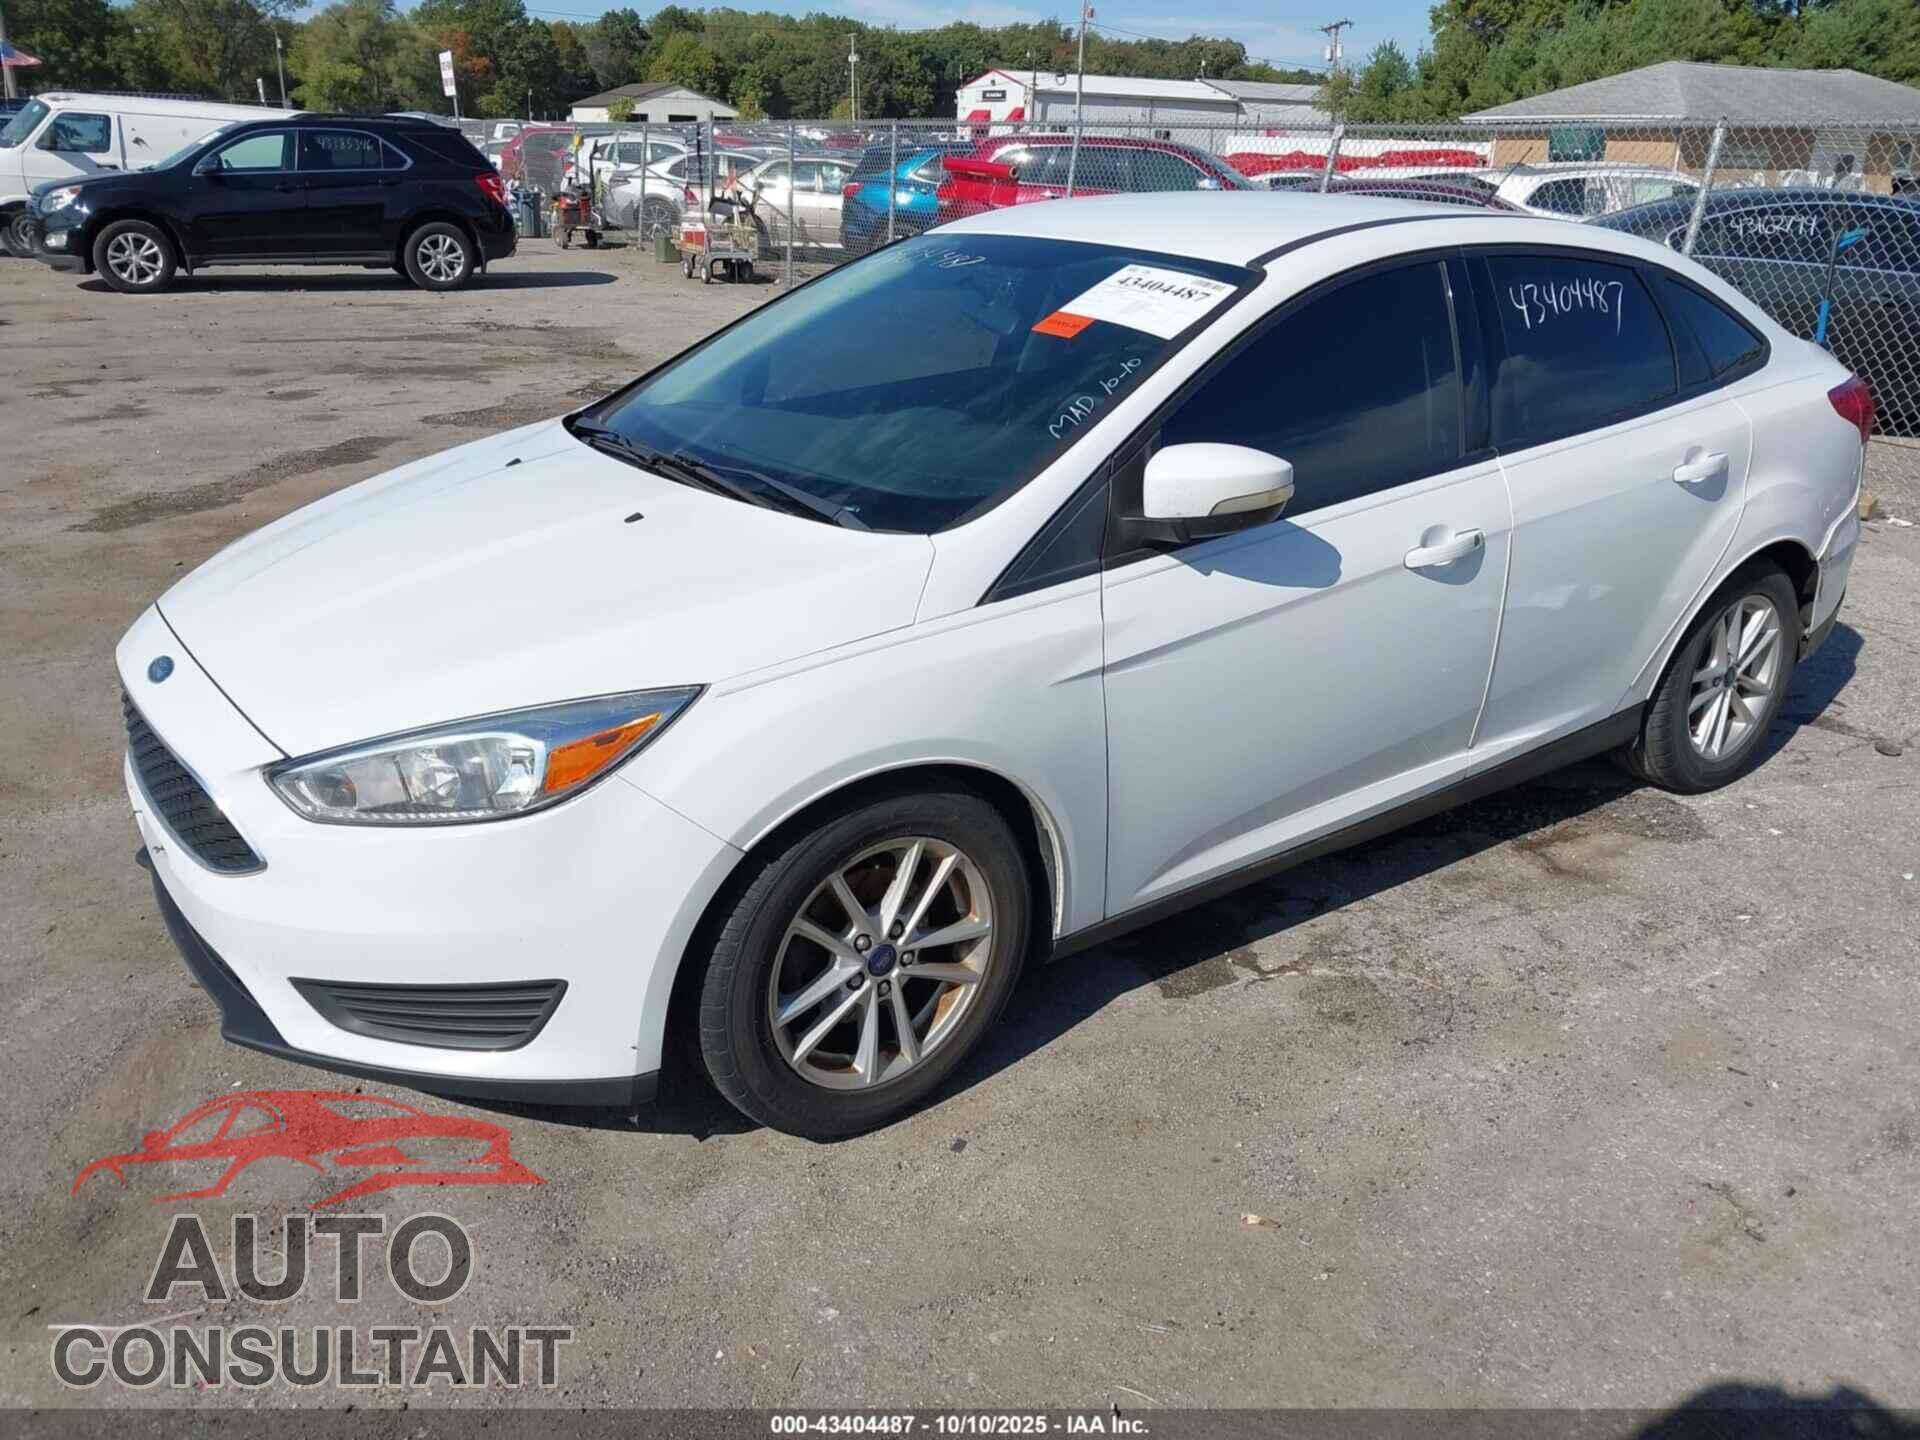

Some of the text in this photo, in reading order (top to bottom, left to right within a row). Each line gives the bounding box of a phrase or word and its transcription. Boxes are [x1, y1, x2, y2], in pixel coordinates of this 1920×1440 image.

[1117, 275, 1212, 302] 43404487
[1509, 277, 1623, 337] 43404487
[1048, 358, 1142, 439] MAD 10-10
